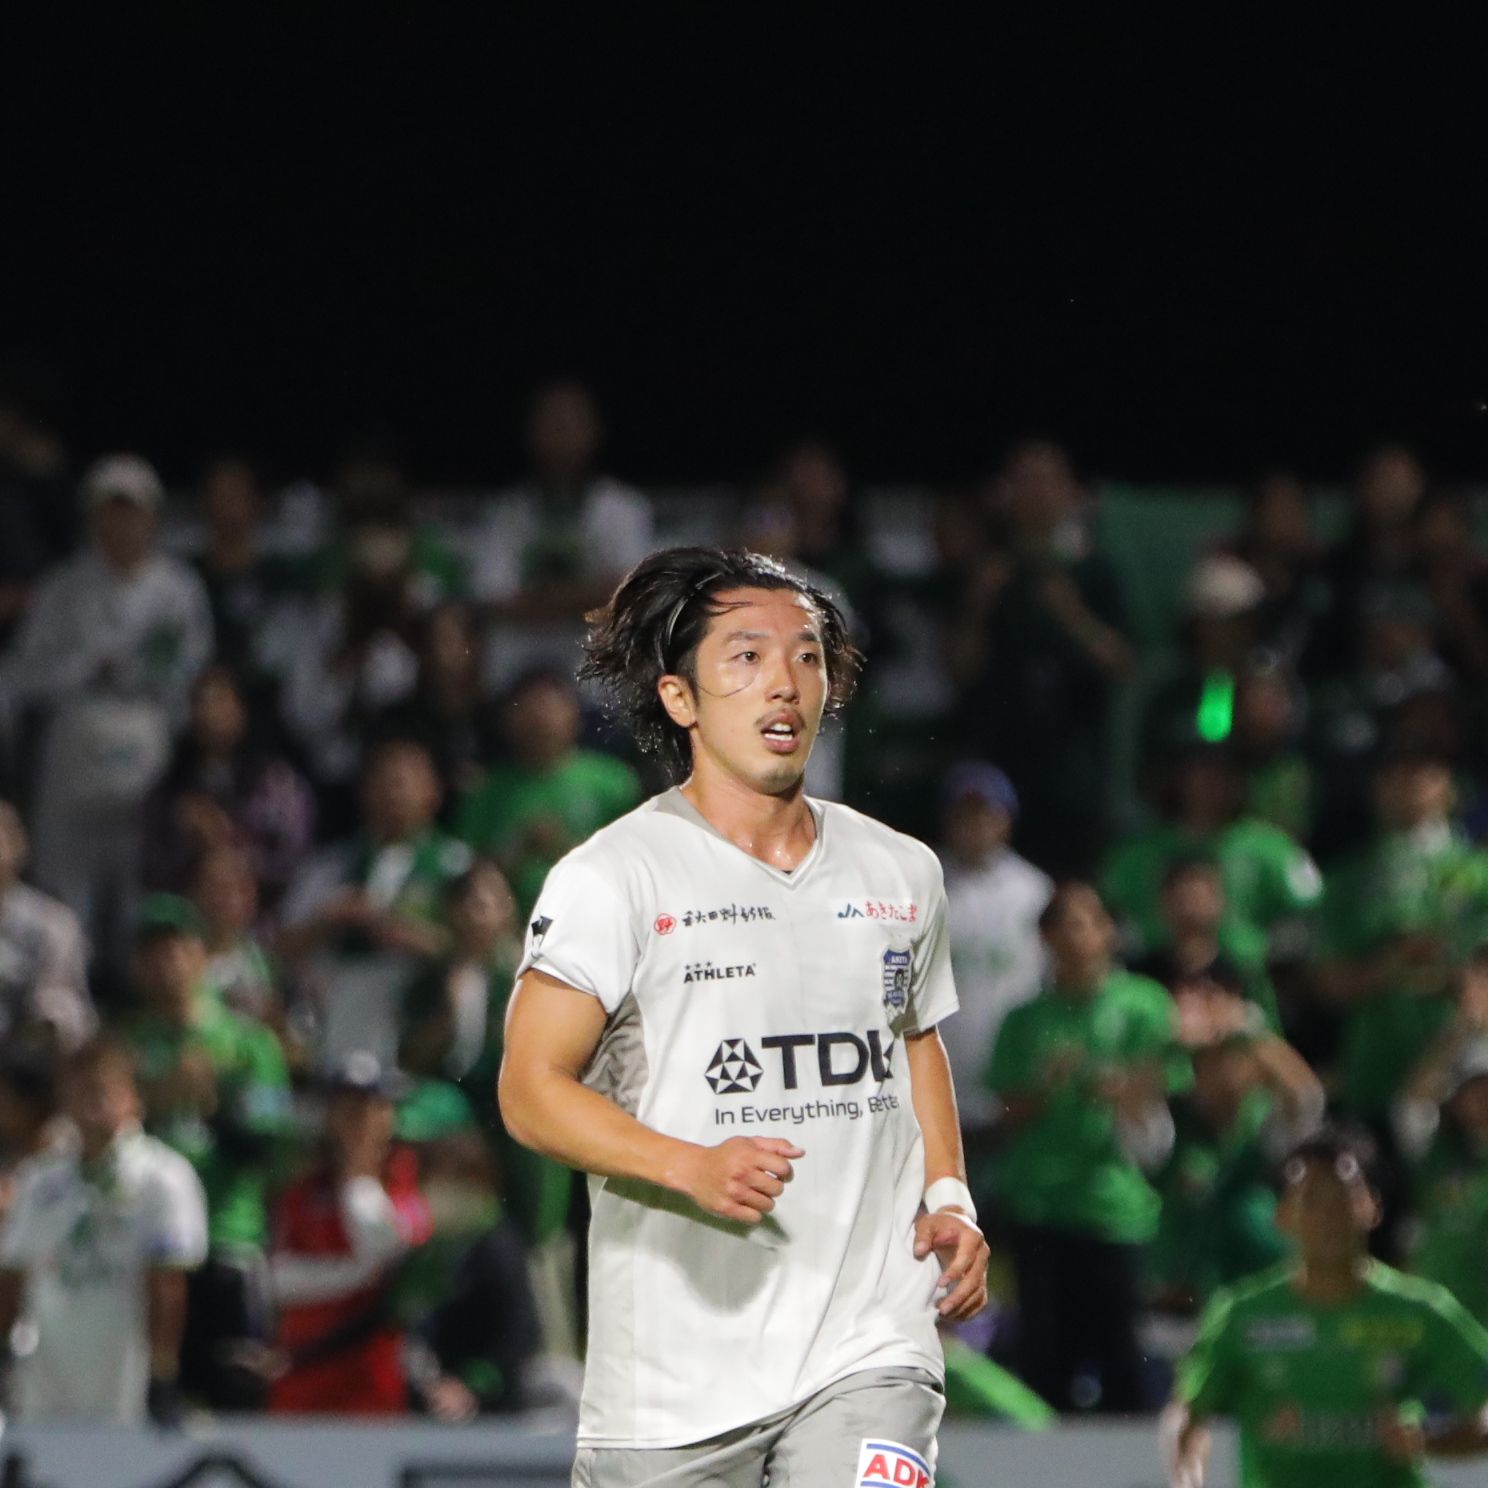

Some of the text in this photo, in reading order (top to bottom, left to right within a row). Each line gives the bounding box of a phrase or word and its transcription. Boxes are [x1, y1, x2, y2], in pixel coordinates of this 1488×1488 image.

[683, 964, 757, 984] ATHLETA
[761, 1029, 895, 1090] TDK
[715, 1108, 734, 1125] In
[741, 1101, 863, 1124] Everything,
